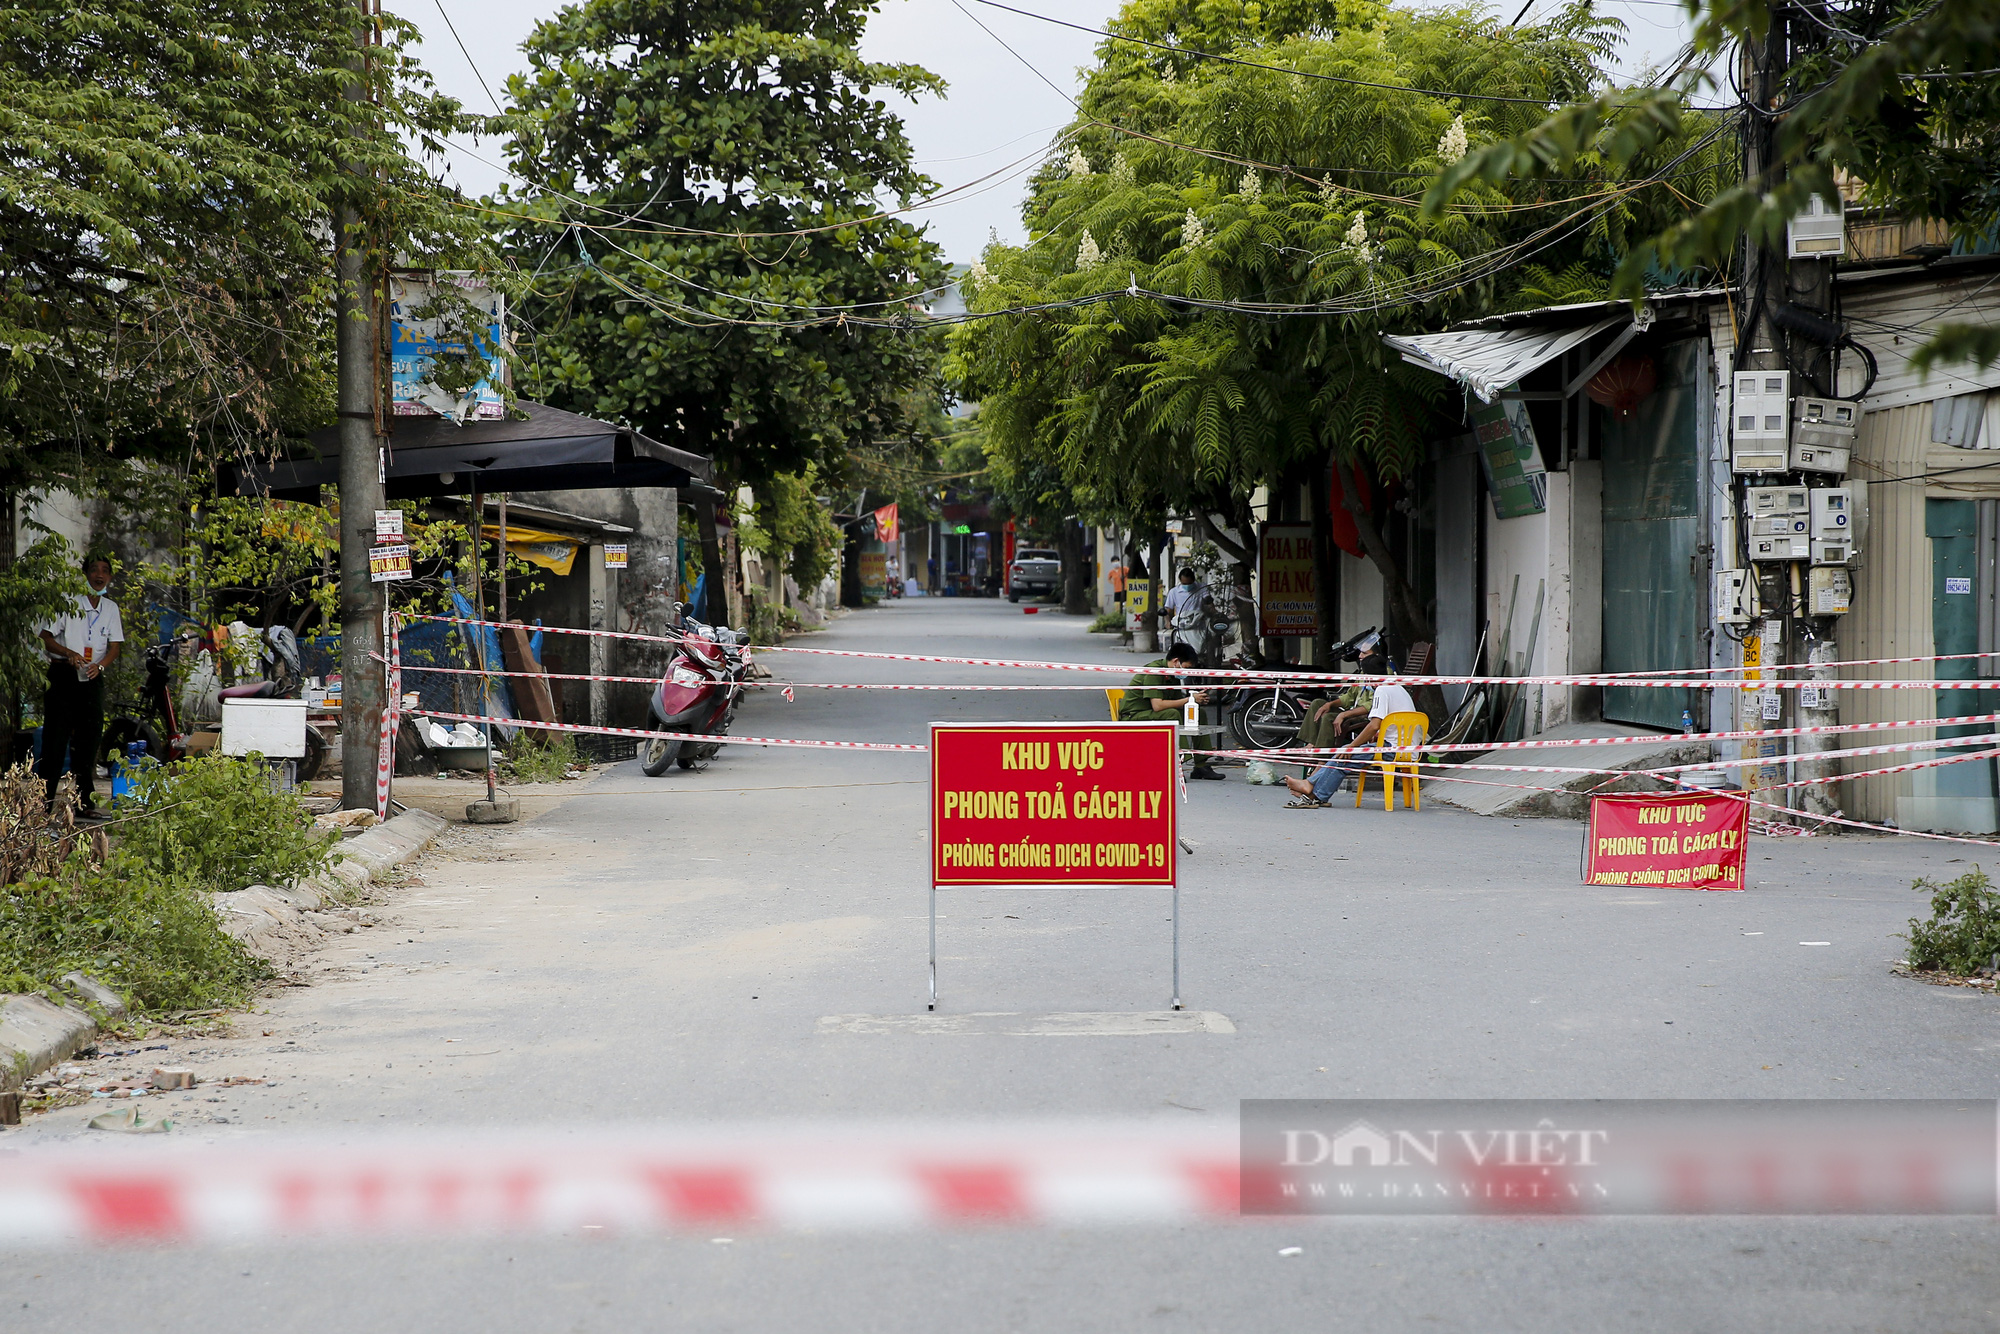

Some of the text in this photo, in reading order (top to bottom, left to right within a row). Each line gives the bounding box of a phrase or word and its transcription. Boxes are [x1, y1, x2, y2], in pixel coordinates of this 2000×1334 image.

[1266, 538, 1293, 560] BIA
[1268, 565, 1291, 593] HÀ
[1002, 739, 1104, 776] KHU VỰC
[944, 781, 1162, 819] PHONG TOẢ CÁCH LY
[1638, 802, 1706, 826] KHU VỰC
[942, 835, 1165, 872] PHÒNG CHỐNG DỊCH COVID-19
[1598, 829, 1738, 856] PHONG TOẢ CÁCH LY
[1593, 863, 1736, 886] PHÒNG CHỐNG DỊCH COVID-19
